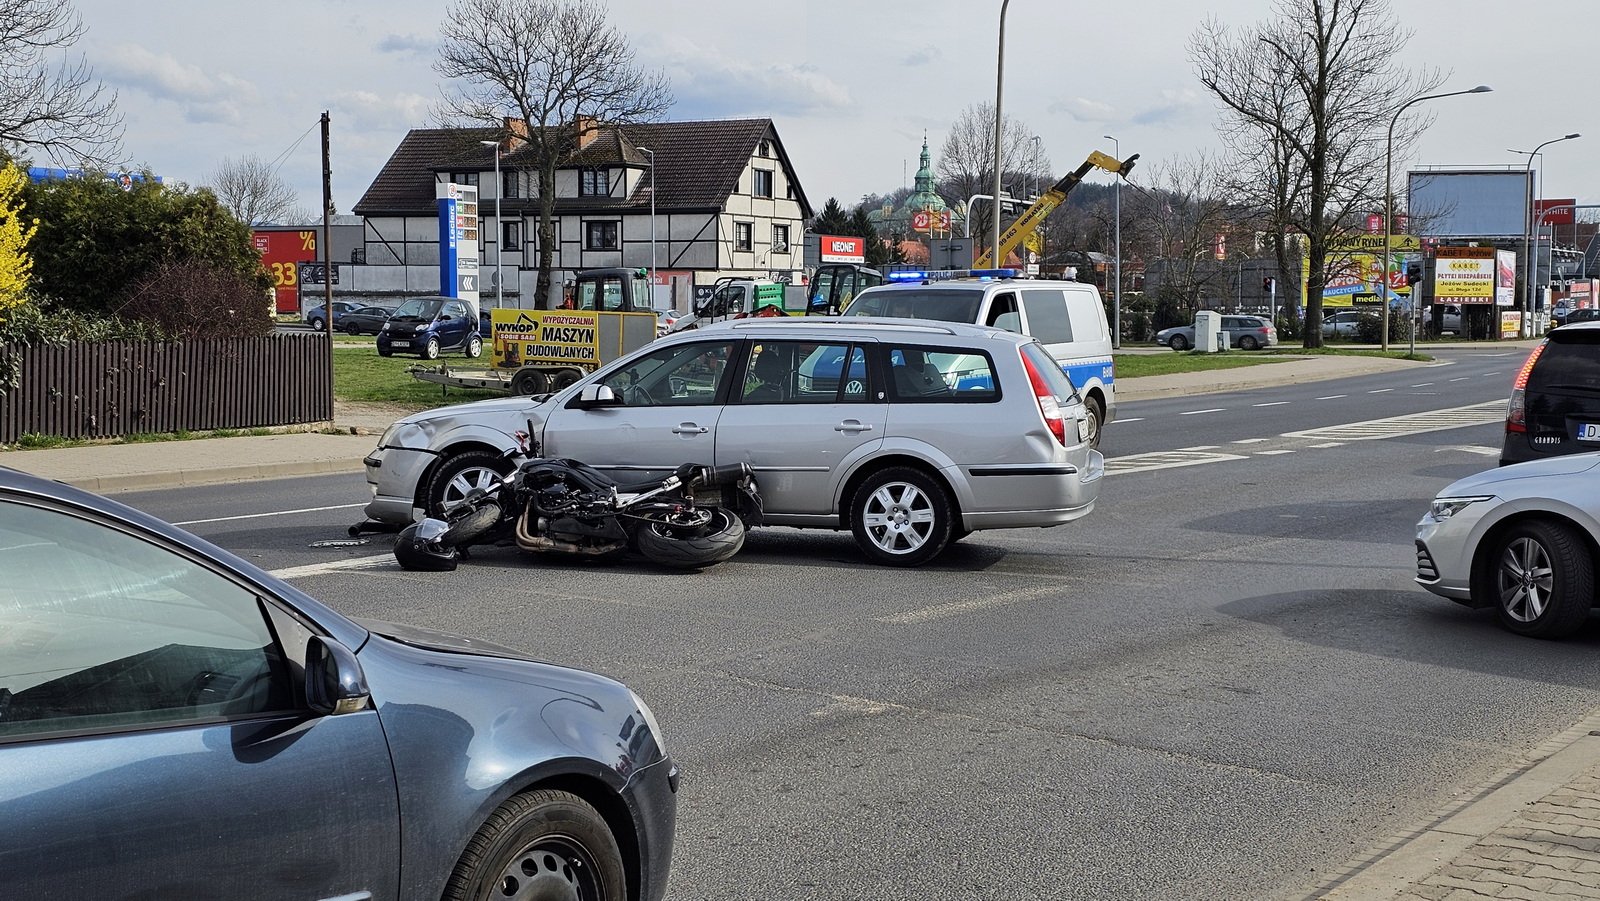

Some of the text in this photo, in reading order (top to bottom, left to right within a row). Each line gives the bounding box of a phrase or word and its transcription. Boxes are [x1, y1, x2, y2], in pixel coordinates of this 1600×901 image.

[1020, 203, 1044, 227] KOMATSU
[832, 241, 856, 253] NEONET
[1362, 238, 1384, 247] RYNE
[271, 262, 297, 286] 33
[542, 314, 594, 326] WYPOŻYCZALNIA
[495, 323, 533, 333] WYKOP
[541, 326, 595, 344] MASZYN
[526, 344, 595, 359] BUDOWLANYCH
